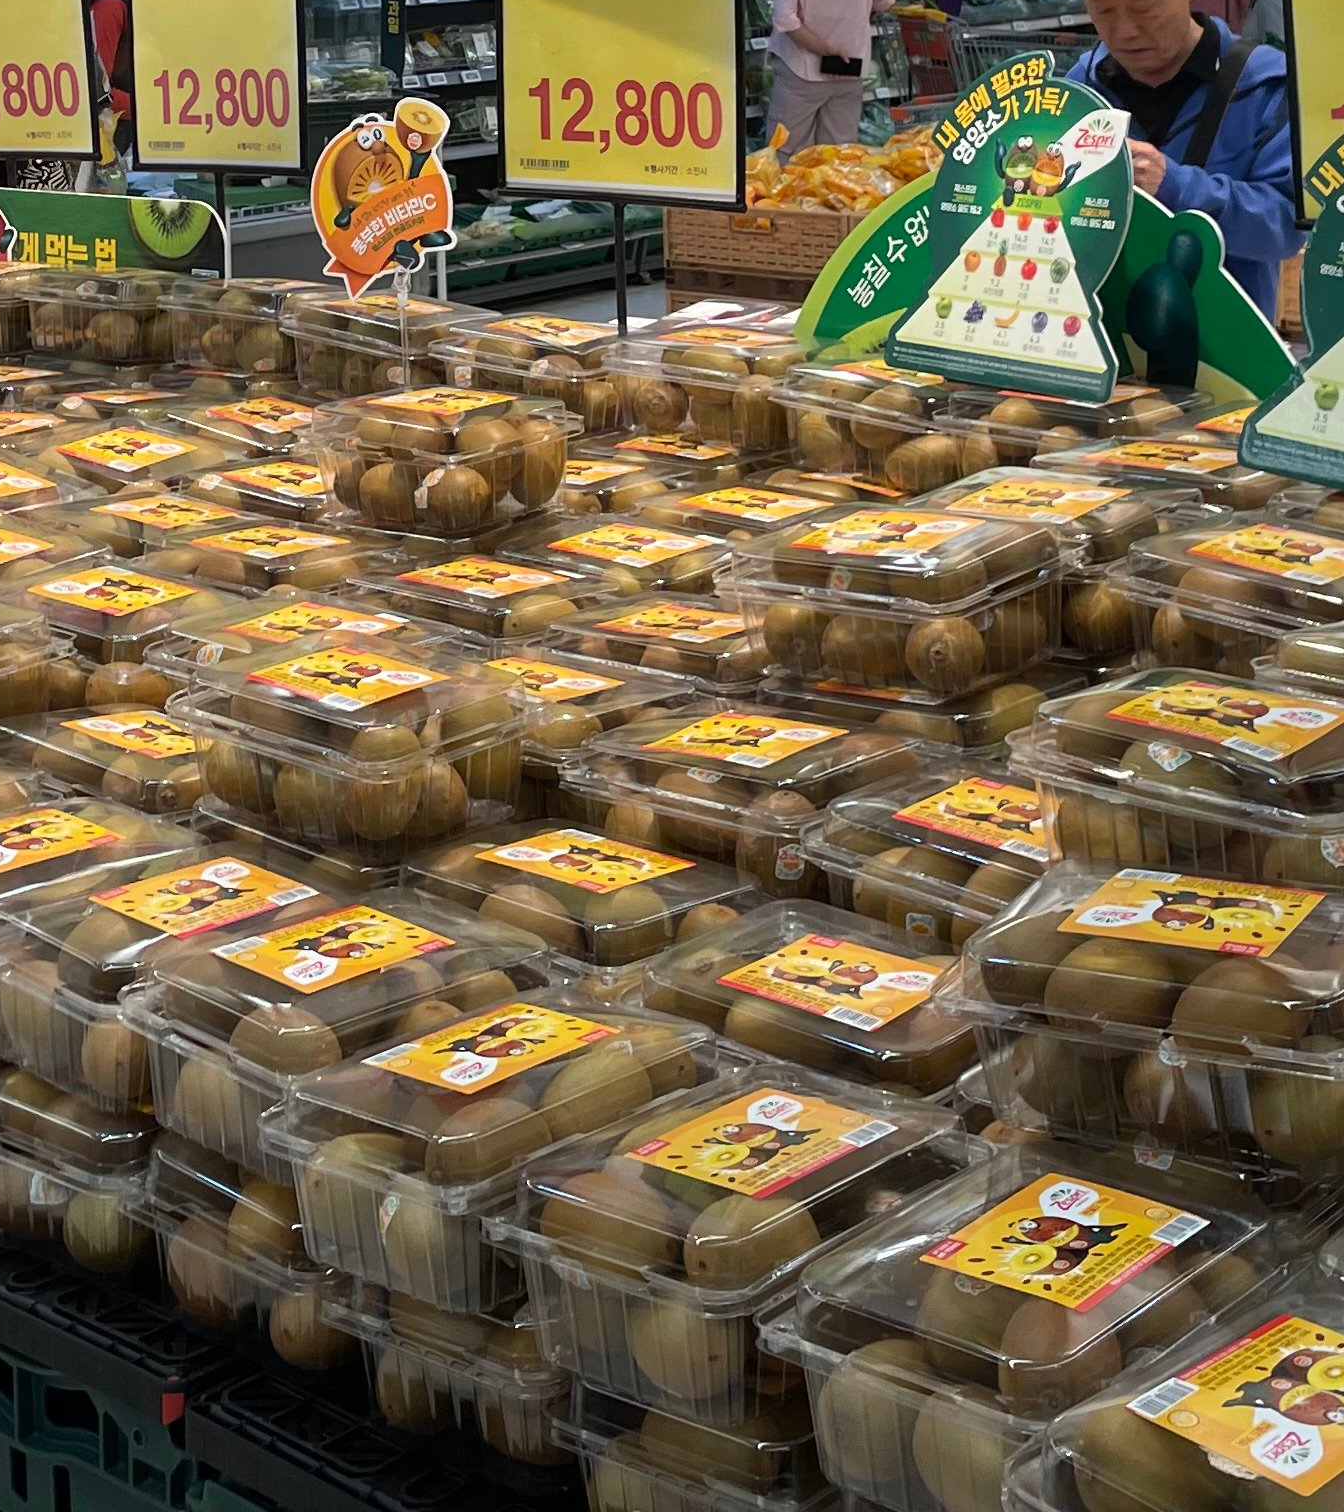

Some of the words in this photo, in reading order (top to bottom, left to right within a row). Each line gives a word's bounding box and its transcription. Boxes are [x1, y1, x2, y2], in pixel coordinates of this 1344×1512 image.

[153, 68, 290, 134] 12,800
[528, 77, 722, 154] 12,800
[935, 120, 959, 149] 내
[954, 84, 992, 128] 몸에
[991, 58, 1046, 99] 필요한
[952, 97, 1020, 165] 영양소가
[1023, 87, 1070, 116] 가득!
[1074, 128, 1116, 149] Zespri
[1015, 197, 1043, 210] ZESPRI
[1310, 161, 1344, 197] 내
[351, 216, 386, 256] 풍부한
[383, 193, 437, 227] 비타민C
[846, 253, 892, 309] 놓칠
[885, 235, 908, 264] 수
[1314, 412, 1329, 423] 3.5
[1050, 1188, 1090, 1210] Zespri
[1262, 1431, 1311, 1465] Zespri
